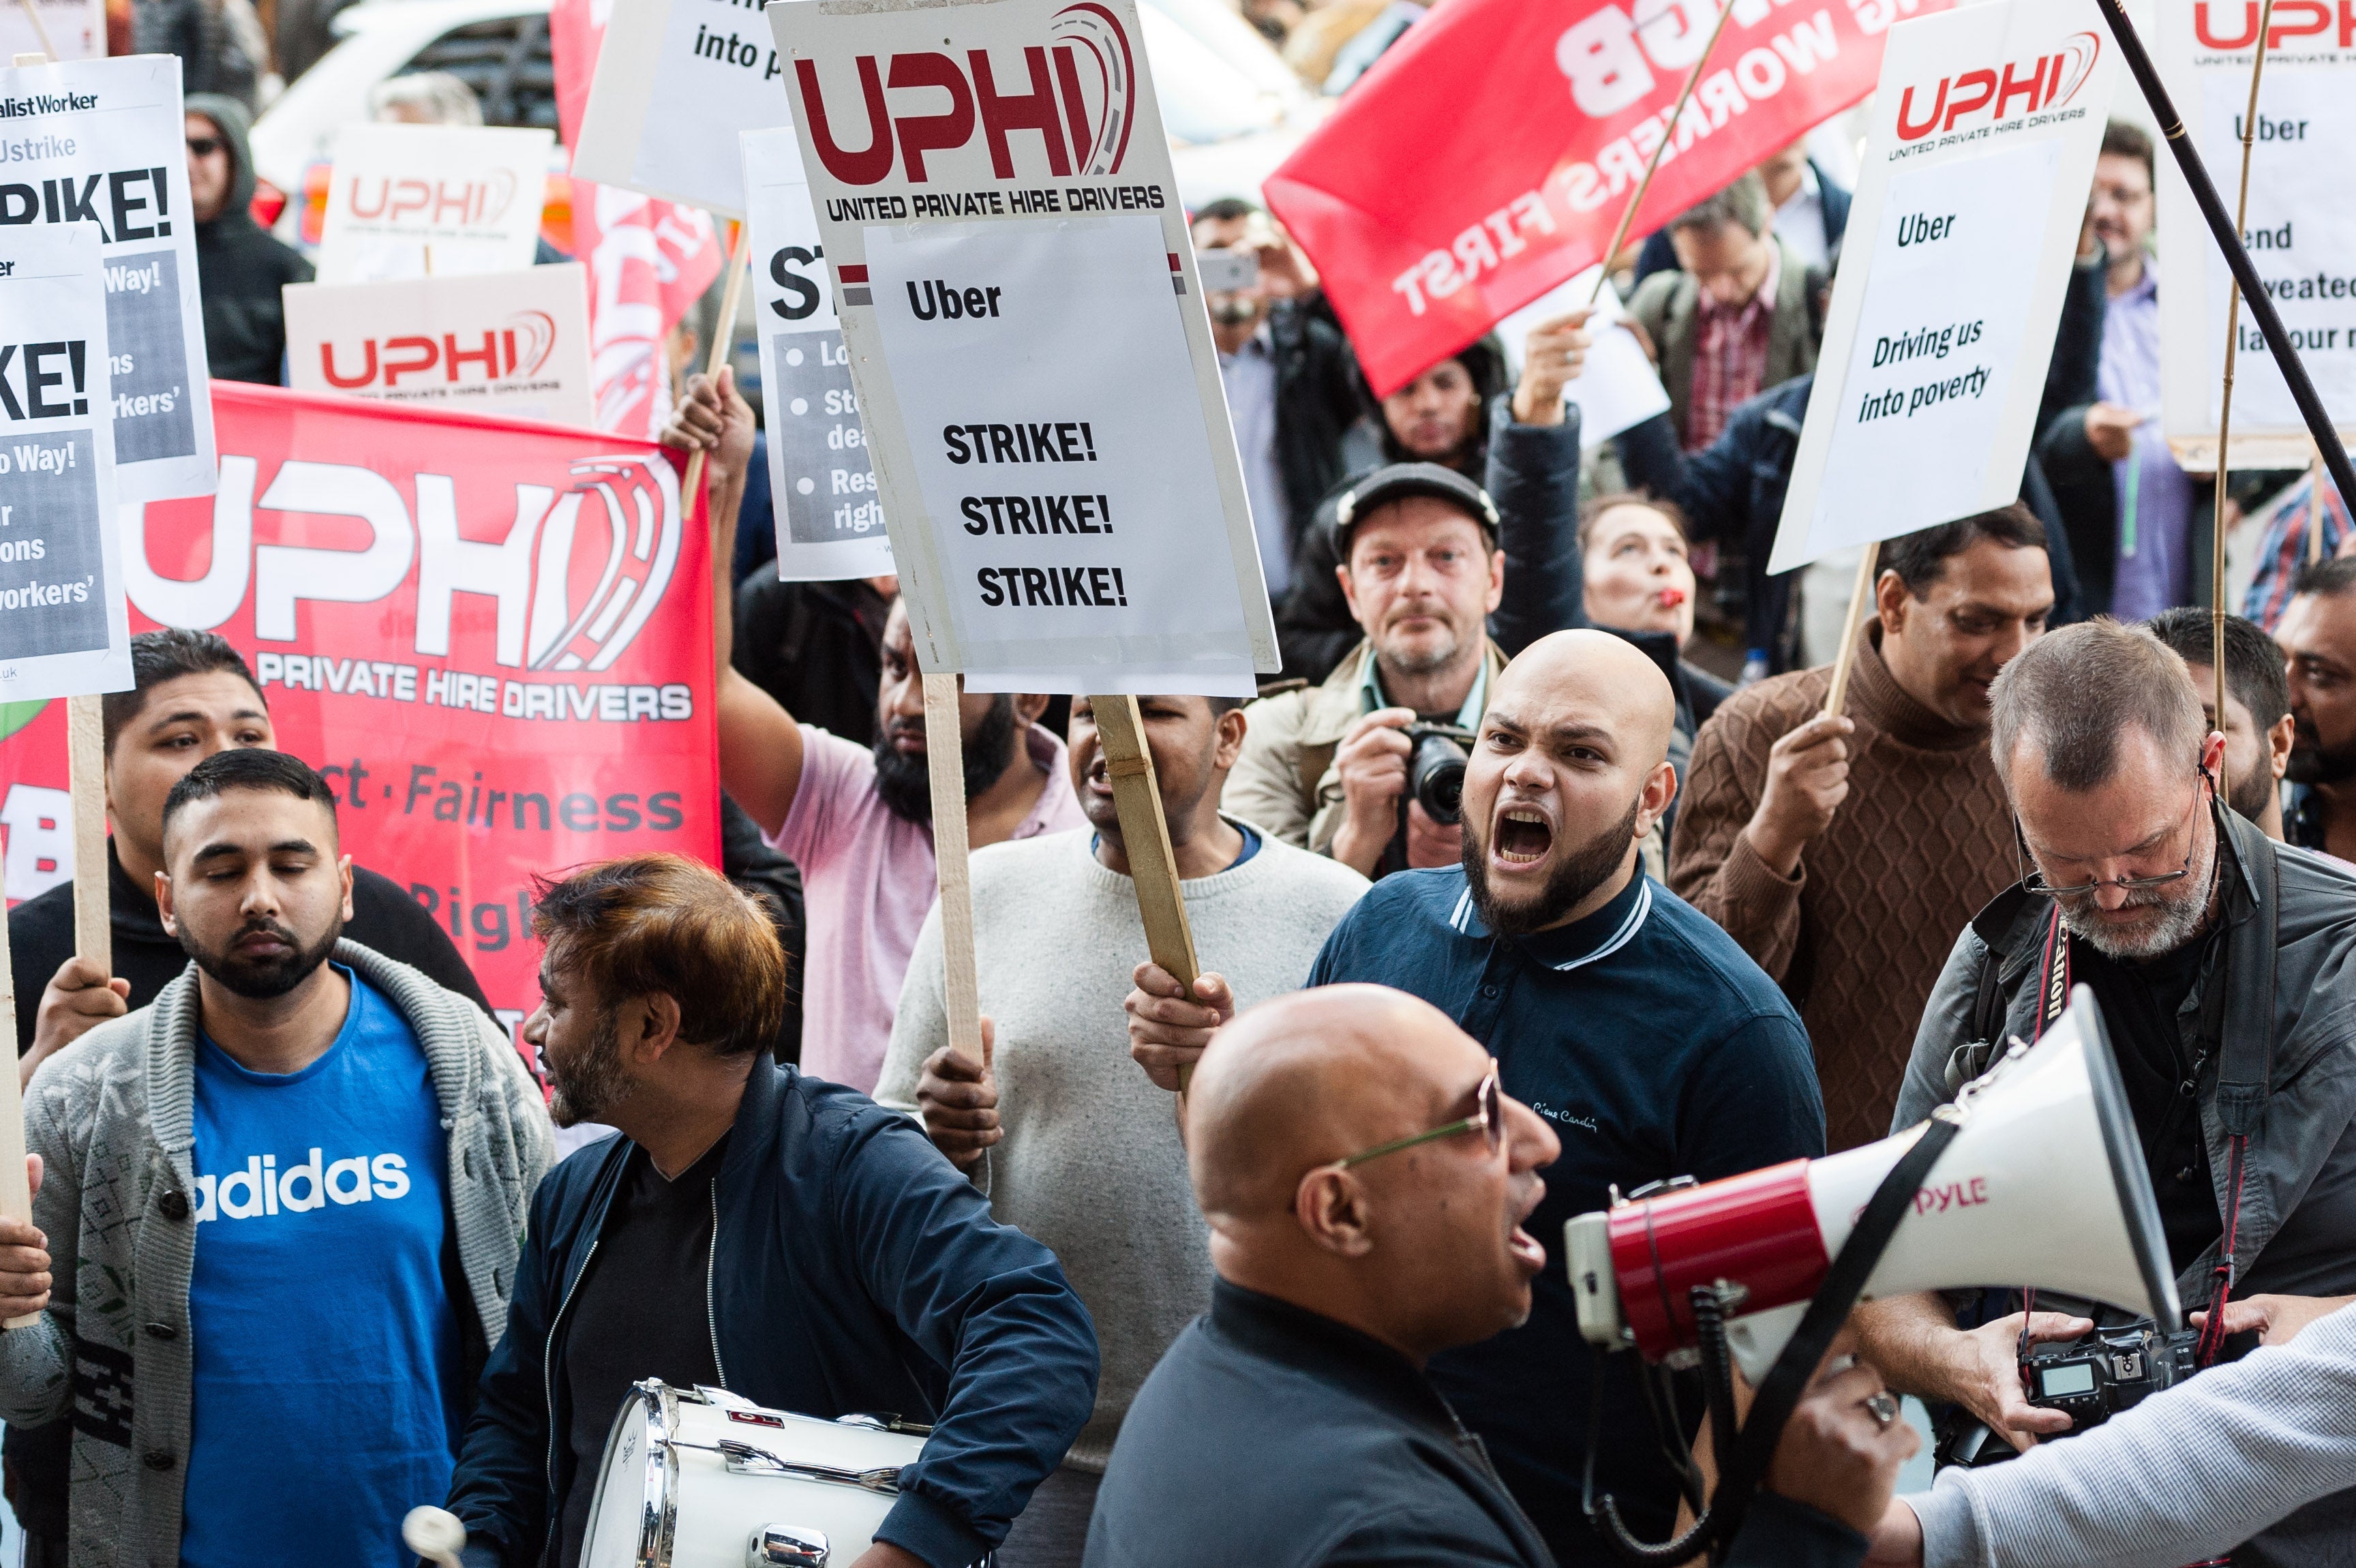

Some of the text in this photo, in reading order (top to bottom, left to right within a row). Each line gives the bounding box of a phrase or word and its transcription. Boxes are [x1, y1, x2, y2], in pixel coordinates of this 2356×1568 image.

[694, 24, 757, 67] into
[794, 46, 1093, 185] UPHI
[1897, 53, 2066, 140] UPHI
[1889, 107, 2086, 162] UNITED PRIVATE HIRE DRIVERS
[350, 176, 486, 225] UPHI
[826, 185, 1165, 222] UNITED PRIVATE HIRE DRIVERS
[1897, 213, 1956, 247] Uber
[906, 280, 1001, 320] Uber
[320, 330, 517, 389] UPHI
[1872, 319, 1983, 369] Driving us
[2239, 325, 2338, 350] laour
[1858, 364, 1992, 423] into poverty
[14, 441, 76, 475] Way!
[943, 422, 1098, 464] STRIKE!
[961, 495, 1113, 535] STRIKE!
[118, 454, 584, 671] UPHI
[977, 567, 1128, 606] STRIKE!
[255, 652, 694, 721] PRIVATE HIRE DRIVERS
[404, 764, 684, 833] Fairness
[2048, 916, 2069, 1020] Canon
[1560, 1110, 1597, 1133] Cardin
[194, 1147, 410, 1225] adidas
